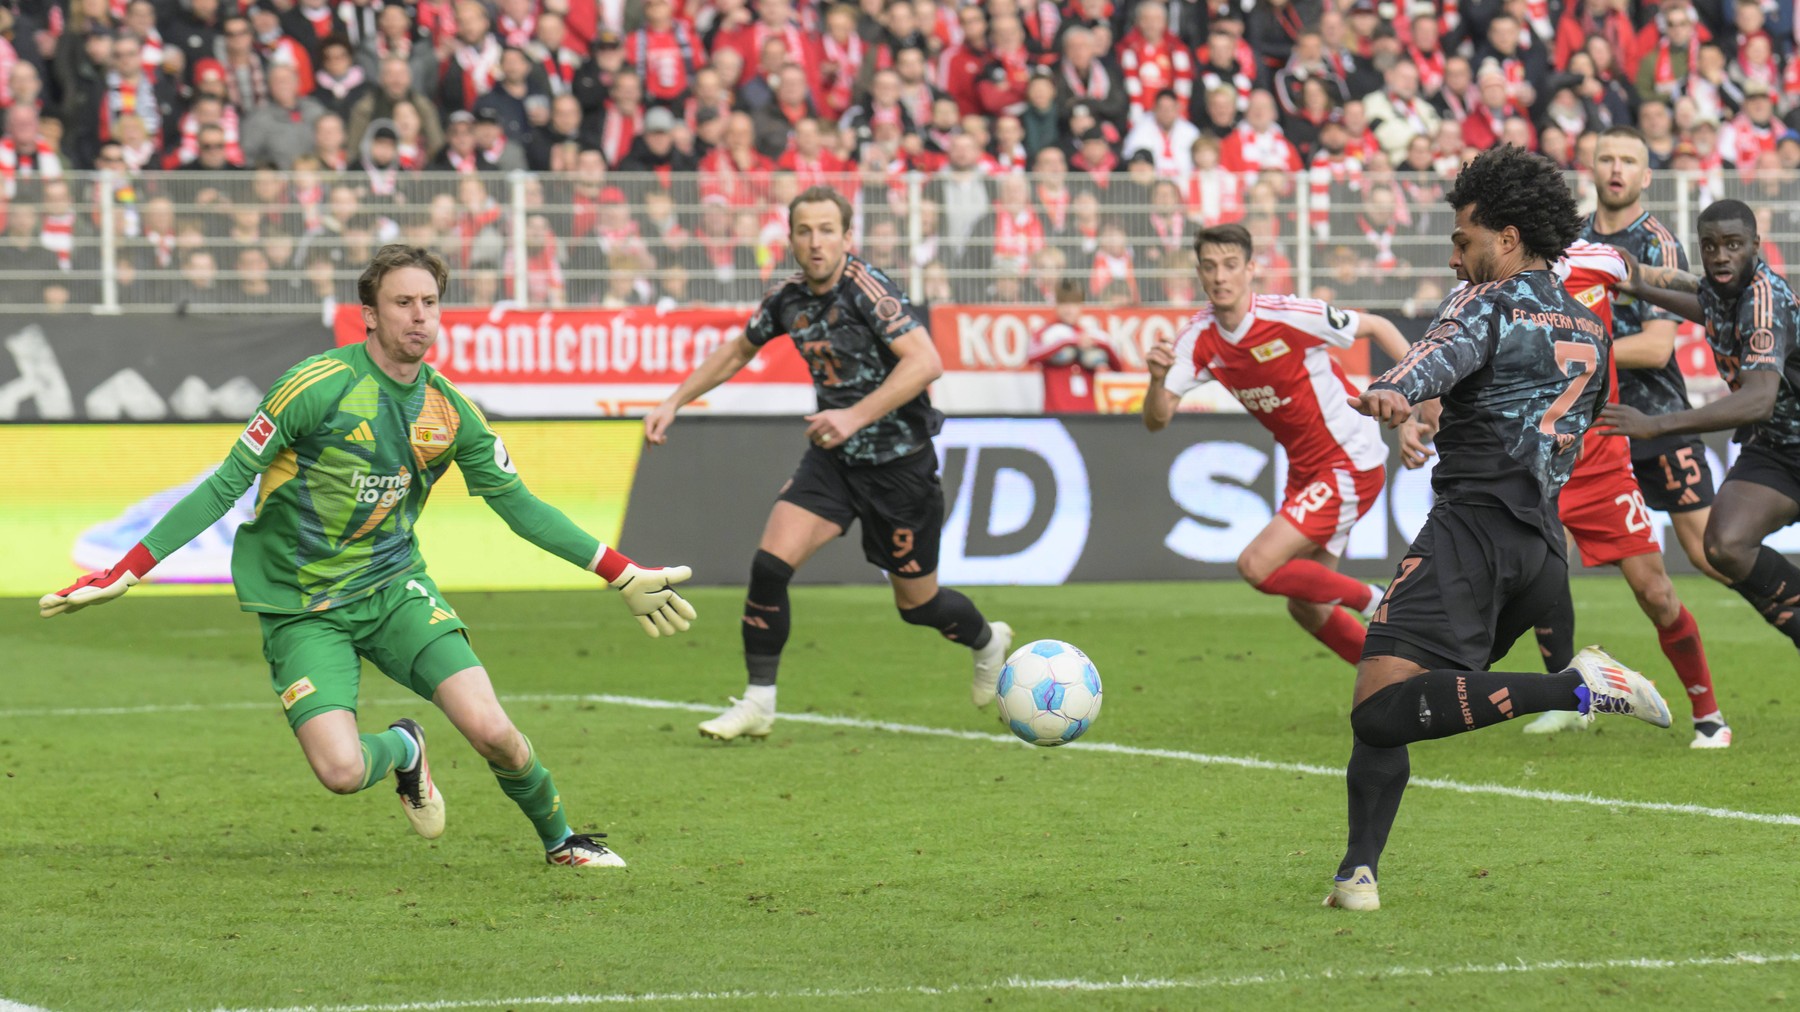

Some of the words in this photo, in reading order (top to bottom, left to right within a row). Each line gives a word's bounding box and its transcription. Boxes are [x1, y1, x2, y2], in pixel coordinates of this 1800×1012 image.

[1513, 308, 1528, 326] FC
[1529, 313, 1575, 330] BAYERN
[1539, 340, 1598, 435] 7
[350, 469, 412, 488] home
[1659, 446, 1701, 490] 15
[355, 487, 380, 503] to
[1614, 489, 1652, 534] 28
[892, 528, 914, 558] 9
[1456, 675, 1474, 725] BAYERN
